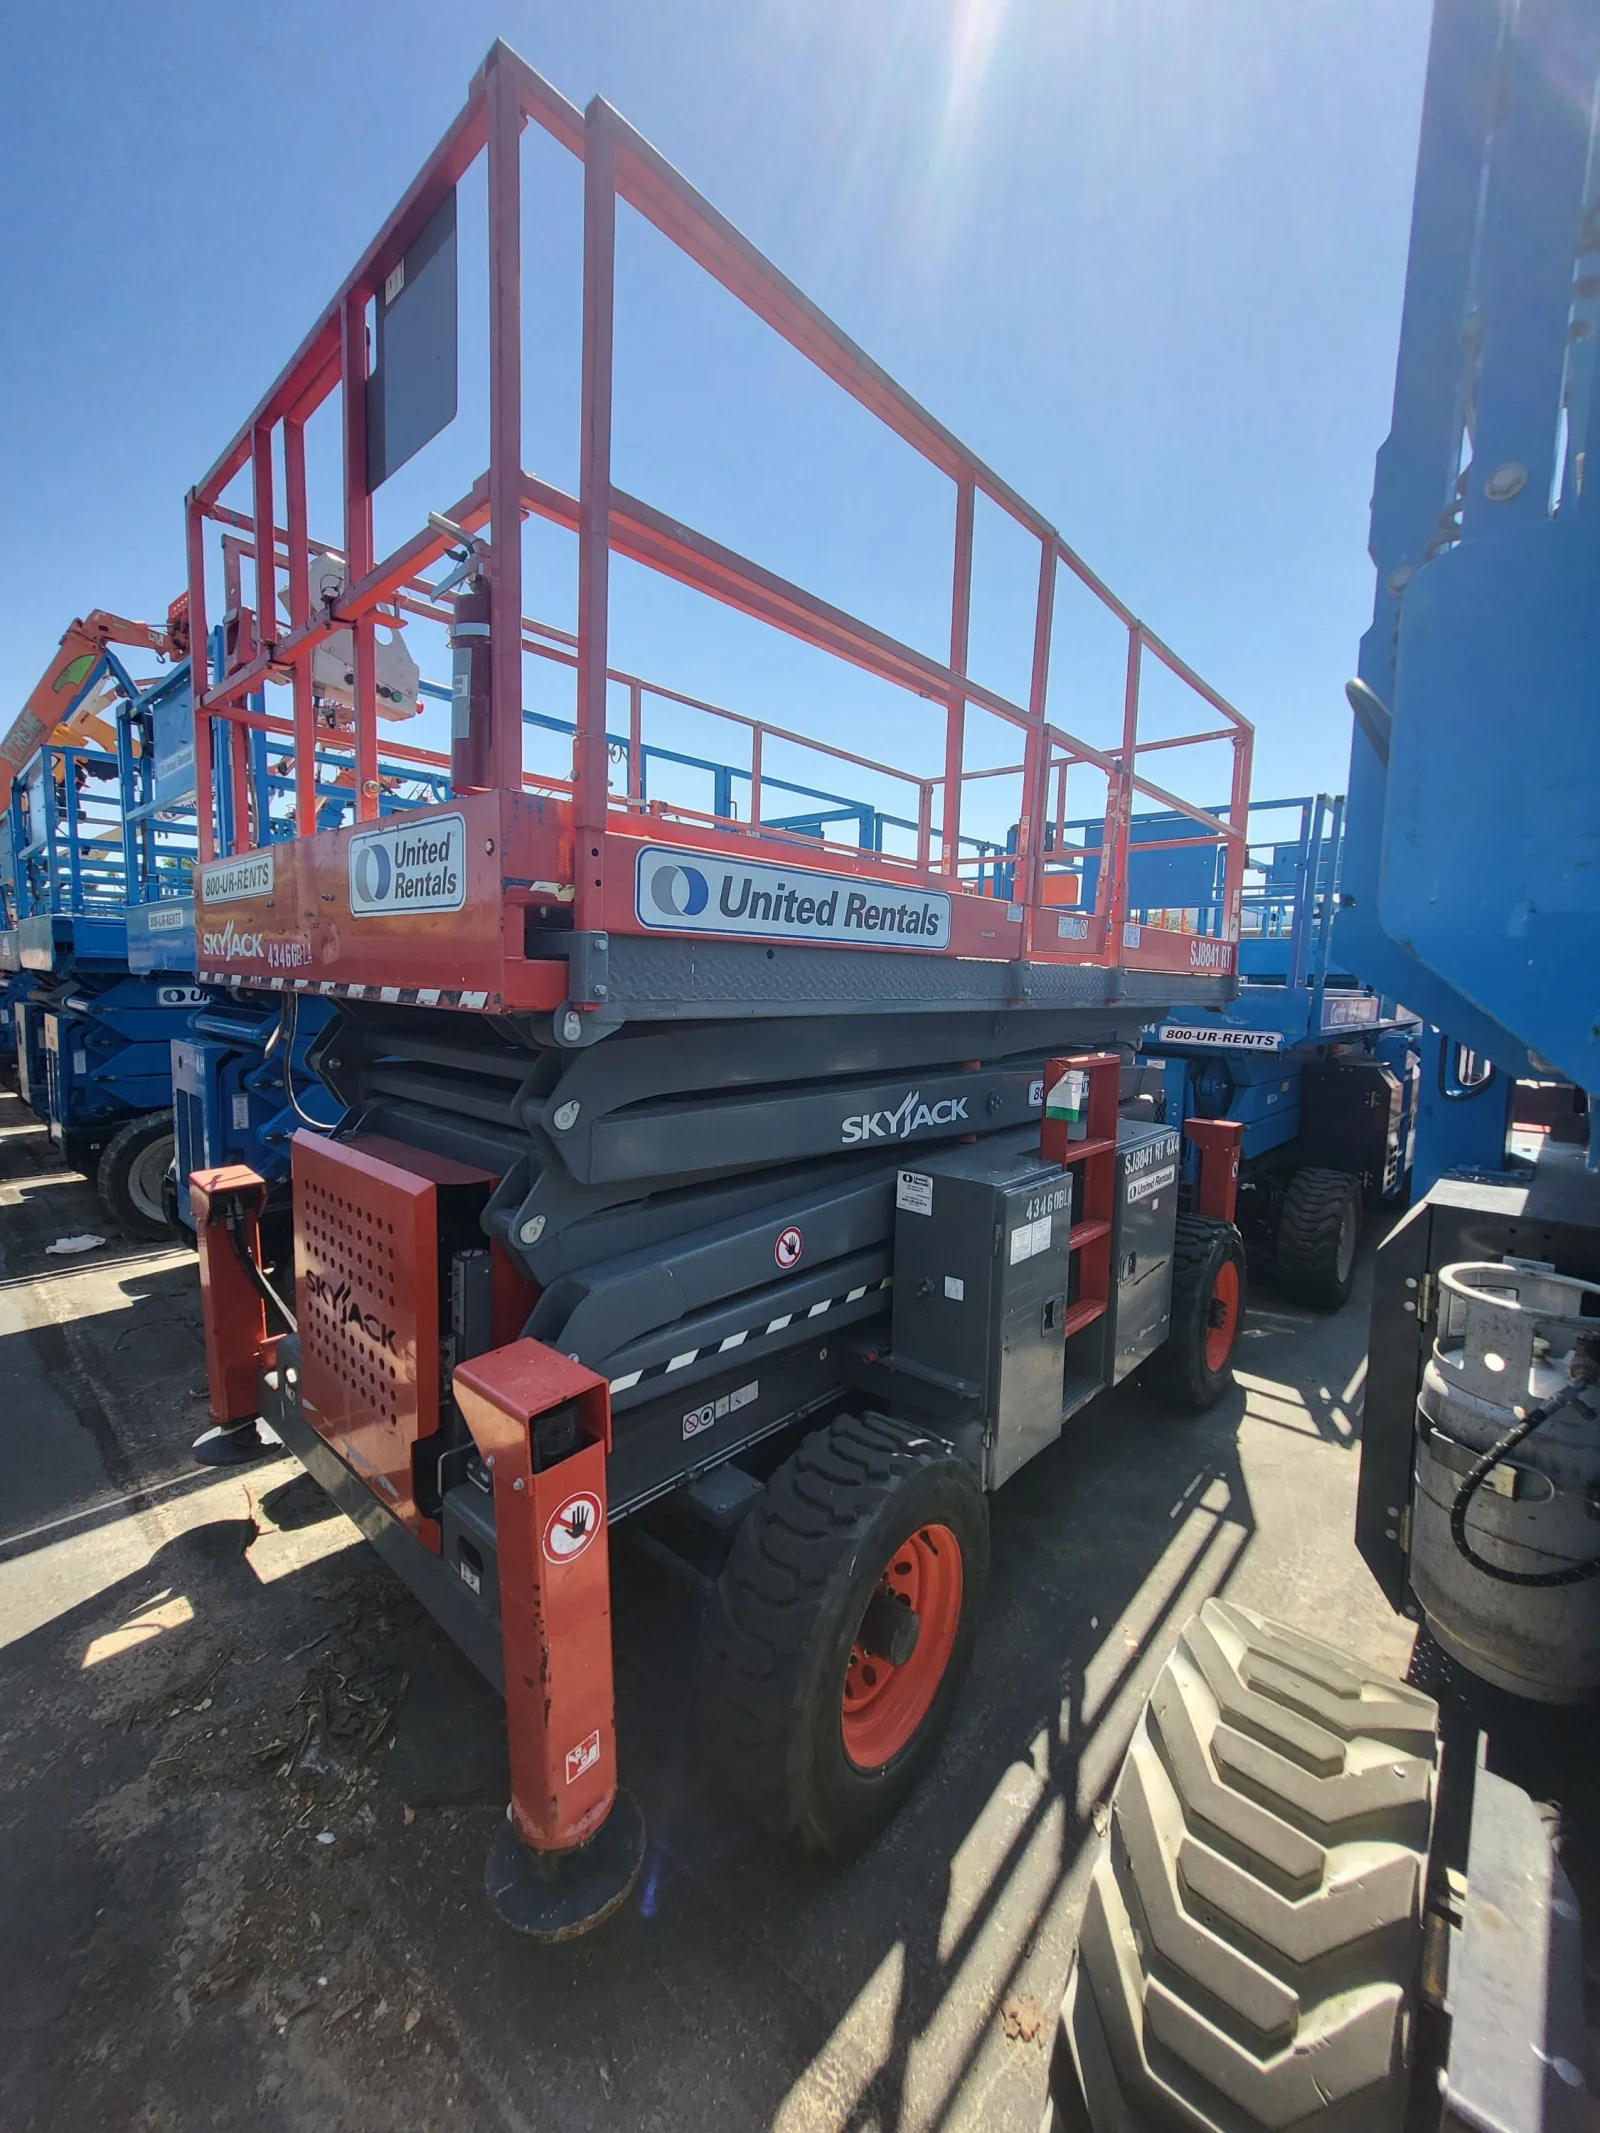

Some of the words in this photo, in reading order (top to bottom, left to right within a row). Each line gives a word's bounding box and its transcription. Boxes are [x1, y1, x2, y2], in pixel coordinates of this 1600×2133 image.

[394, 831, 451, 869] United
[206, 862, 269, 897] 800-UR-RENTS
[394, 866, 457, 899] Rentals
[719, 875, 839, 927] United
[843, 892, 940, 936] Rentals
[203, 917, 265, 962] SKYJACK
[1190, 940, 1220, 968] SJ8841
[1221, 945, 1232, 969] RT
[1166, 1029, 1275, 1046] 800-UR-RENTS
[841, 1089, 970, 1143] SKYJACK
[1125, 1145, 1153, 1175] SJ8841
[1155, 1141, 1165, 1161] RT
[1138, 1177, 1156, 1195] United
[1155, 1170, 1173, 1186] Rentals
[306, 1269, 400, 1359] SKYJACK
